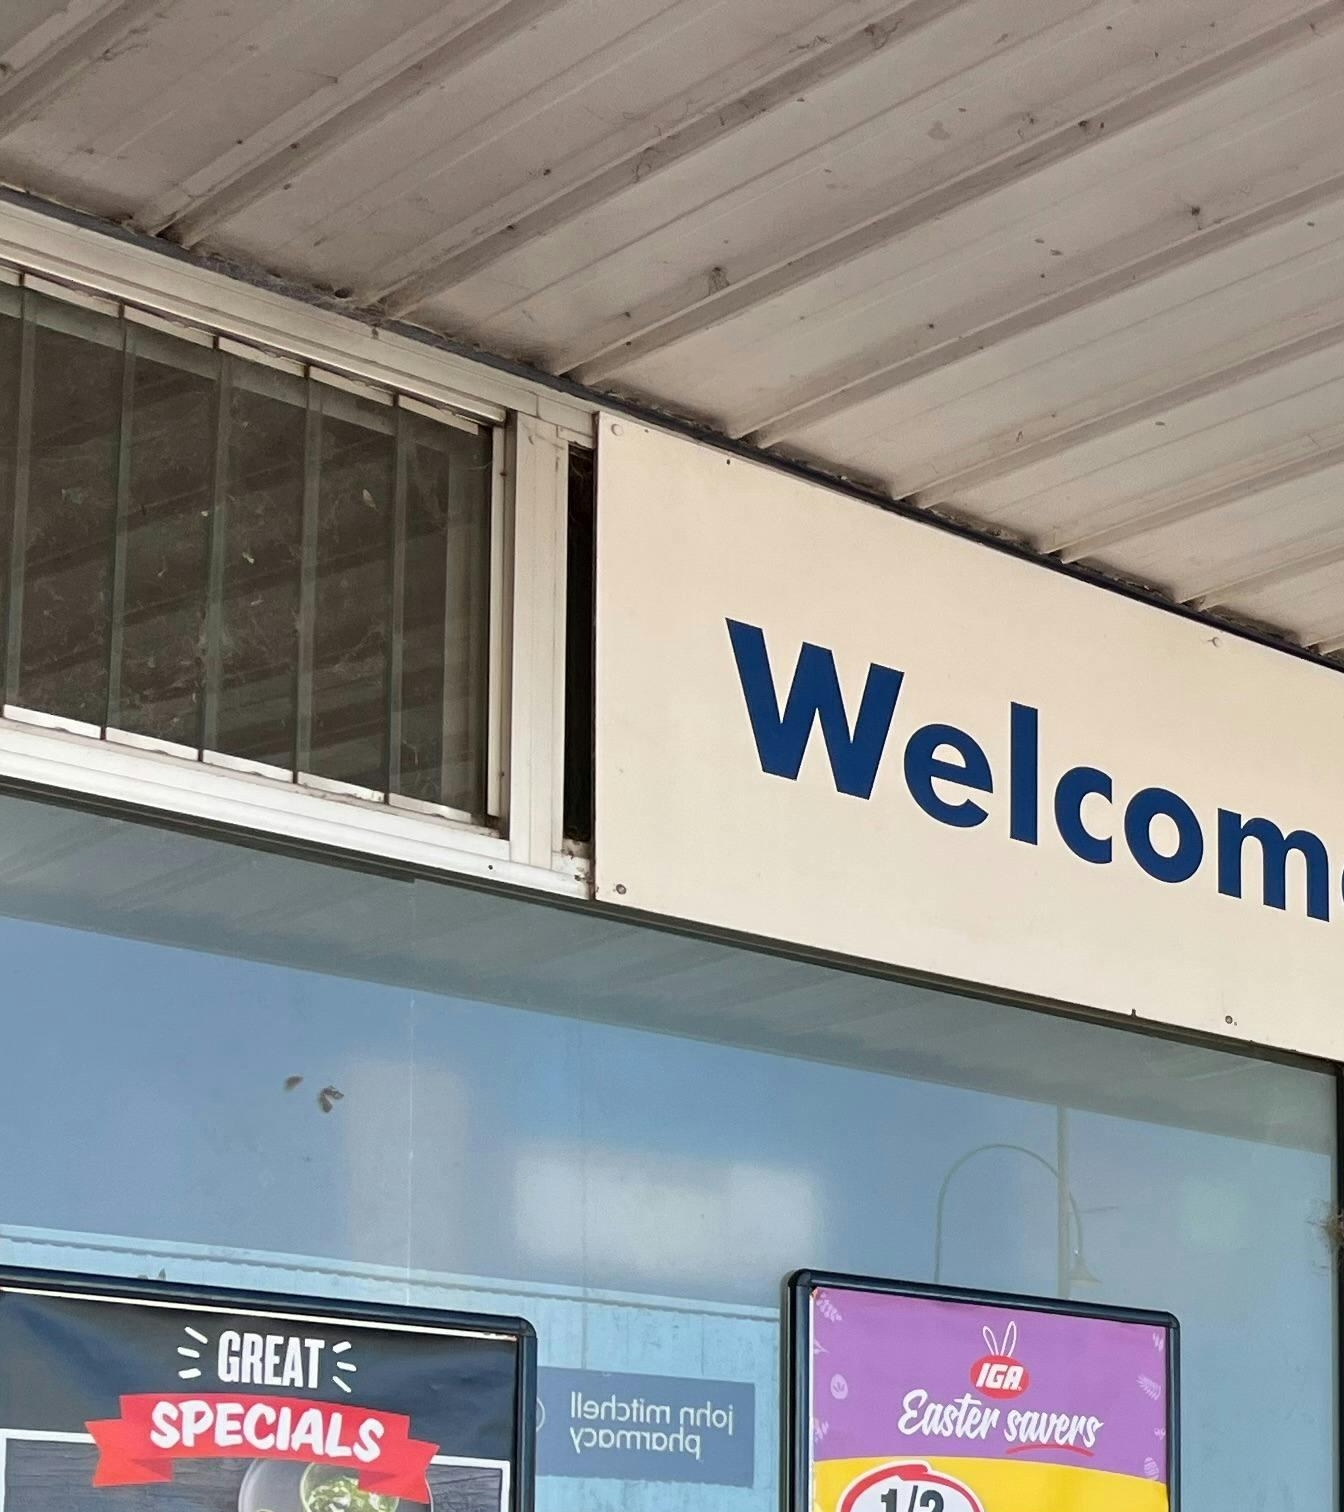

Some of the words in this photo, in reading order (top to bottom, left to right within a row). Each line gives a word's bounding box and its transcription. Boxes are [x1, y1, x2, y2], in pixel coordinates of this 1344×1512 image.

[217, 1331, 325, 1388] GREAT
[976, 1362, 1023, 1391] IGA
[150, 1400, 385, 1461] SPECIALS
[898, 1389, 999, 1440] Easter
[1005, 1408, 1104, 1448] savers
